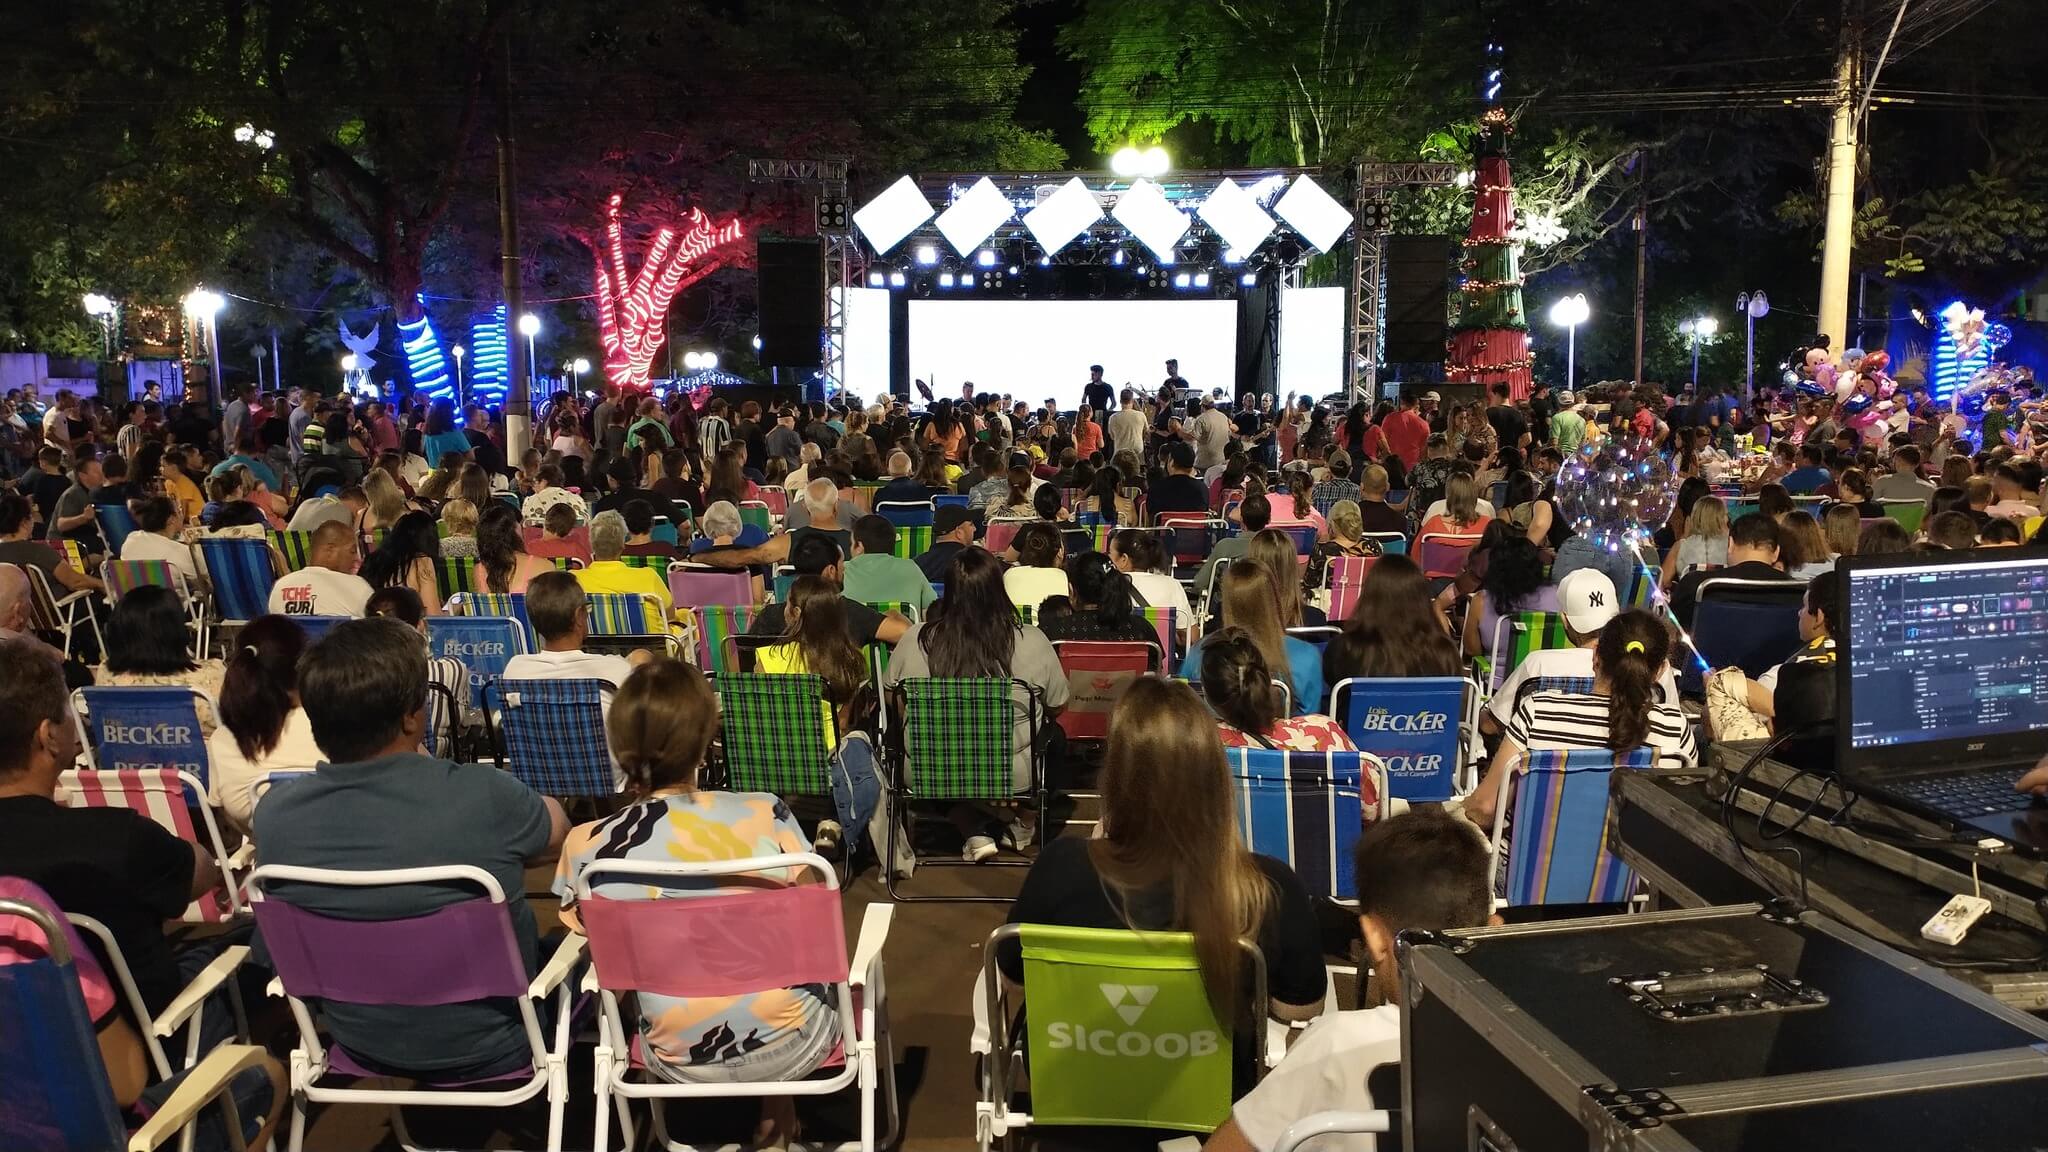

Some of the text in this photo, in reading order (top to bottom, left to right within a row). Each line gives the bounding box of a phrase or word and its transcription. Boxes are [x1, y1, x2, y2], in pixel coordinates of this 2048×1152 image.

[282, 584, 312, 601] TCHÉ
[1589, 591, 1604, 607] NY
[444, 641, 505, 656] BECKER
[1368, 706, 1389, 716] Lojas
[1363, 712, 1448, 731] BECKER
[103, 725, 192, 745] BECKER
[1967, 743, 1985, 751] acer
[1378, 754, 1443, 772] CKER
[1047, 1022, 1219, 1059] SICOOB
